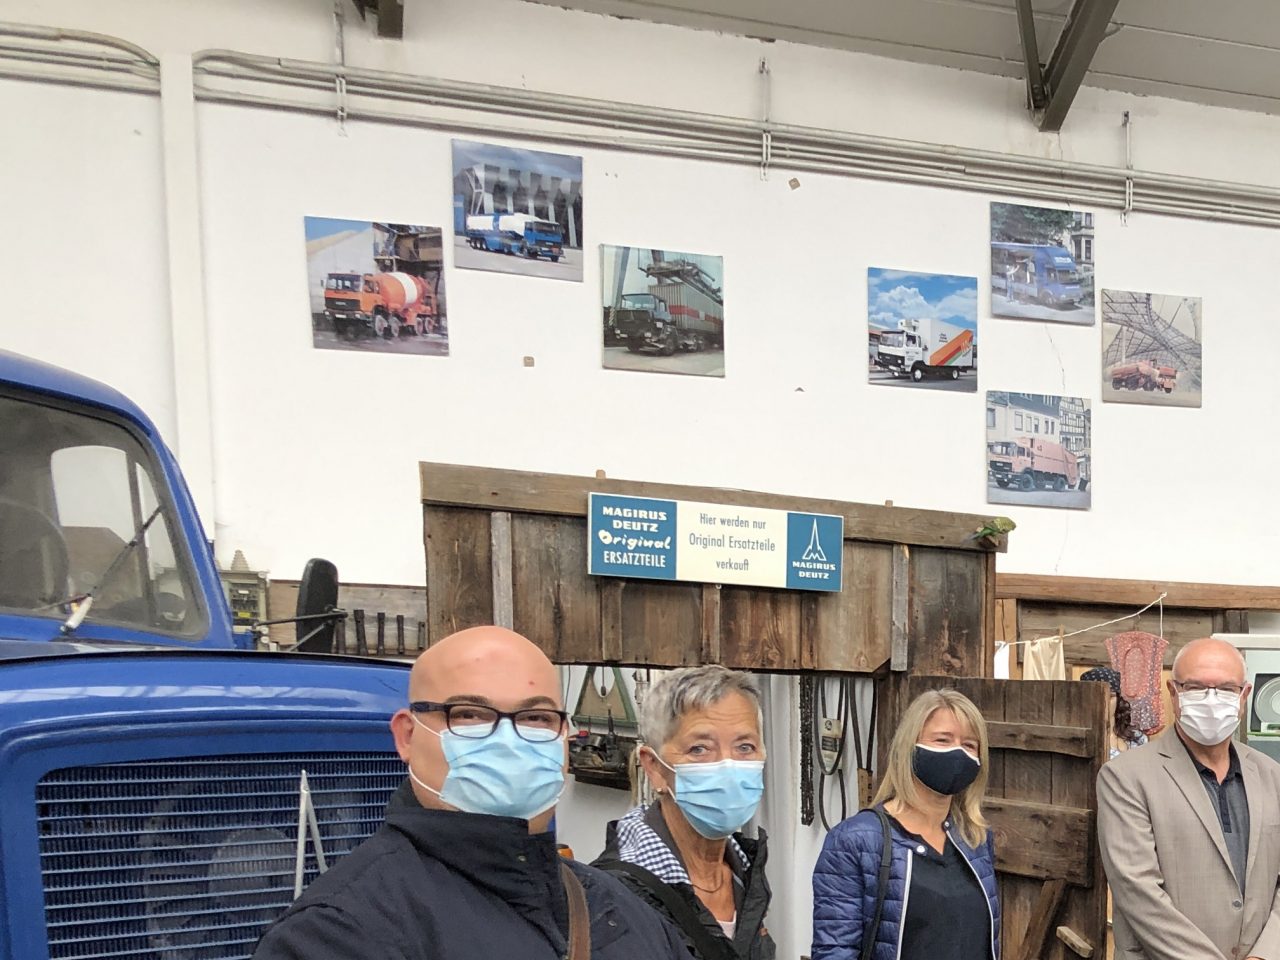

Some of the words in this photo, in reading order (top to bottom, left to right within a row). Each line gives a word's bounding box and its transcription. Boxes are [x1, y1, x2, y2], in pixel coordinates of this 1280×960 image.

[602, 506, 668, 521] MAGIRUS
[699, 512, 717, 525] Hier
[719, 515, 750, 528] werden
[752, 520, 767, 529] nur
[612, 519, 659, 533] DEUTZ
[597, 529, 671, 551] Original
[689, 532, 725, 549] Original
[728, 535, 776, 552] Ersatzteile
[603, 550, 666, 568] ERSATZTEILE
[715, 557, 750, 571] verkauft
[792, 560, 836, 571] MAGIRUS
[798, 570, 830, 580] DEUTZ
